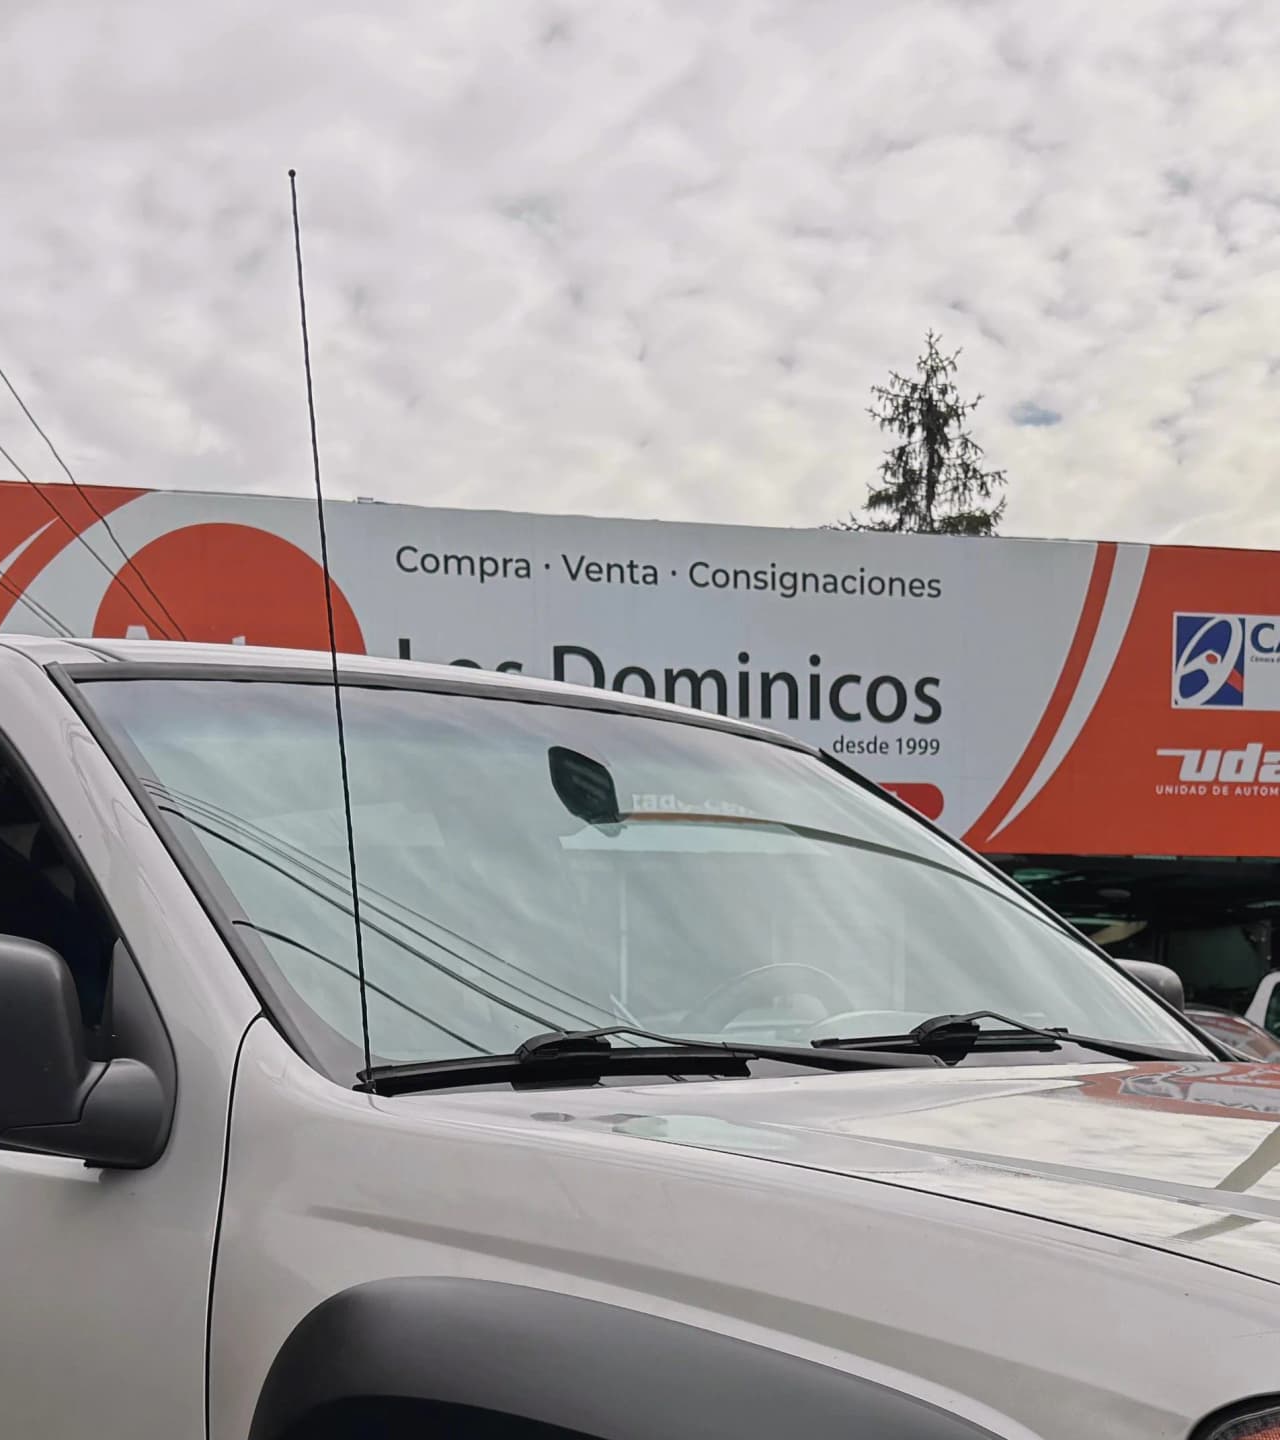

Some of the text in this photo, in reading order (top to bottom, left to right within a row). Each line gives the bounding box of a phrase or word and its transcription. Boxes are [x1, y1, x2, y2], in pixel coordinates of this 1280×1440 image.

[396, 546, 942, 600] Compra Venta Consignaciones
[552, 645, 942, 724] Dominicos
[833, 736, 941, 756] desde 1999
[1155, 785, 1207, 795] UNIDAD
[1212, 785, 1229, 796] DE
